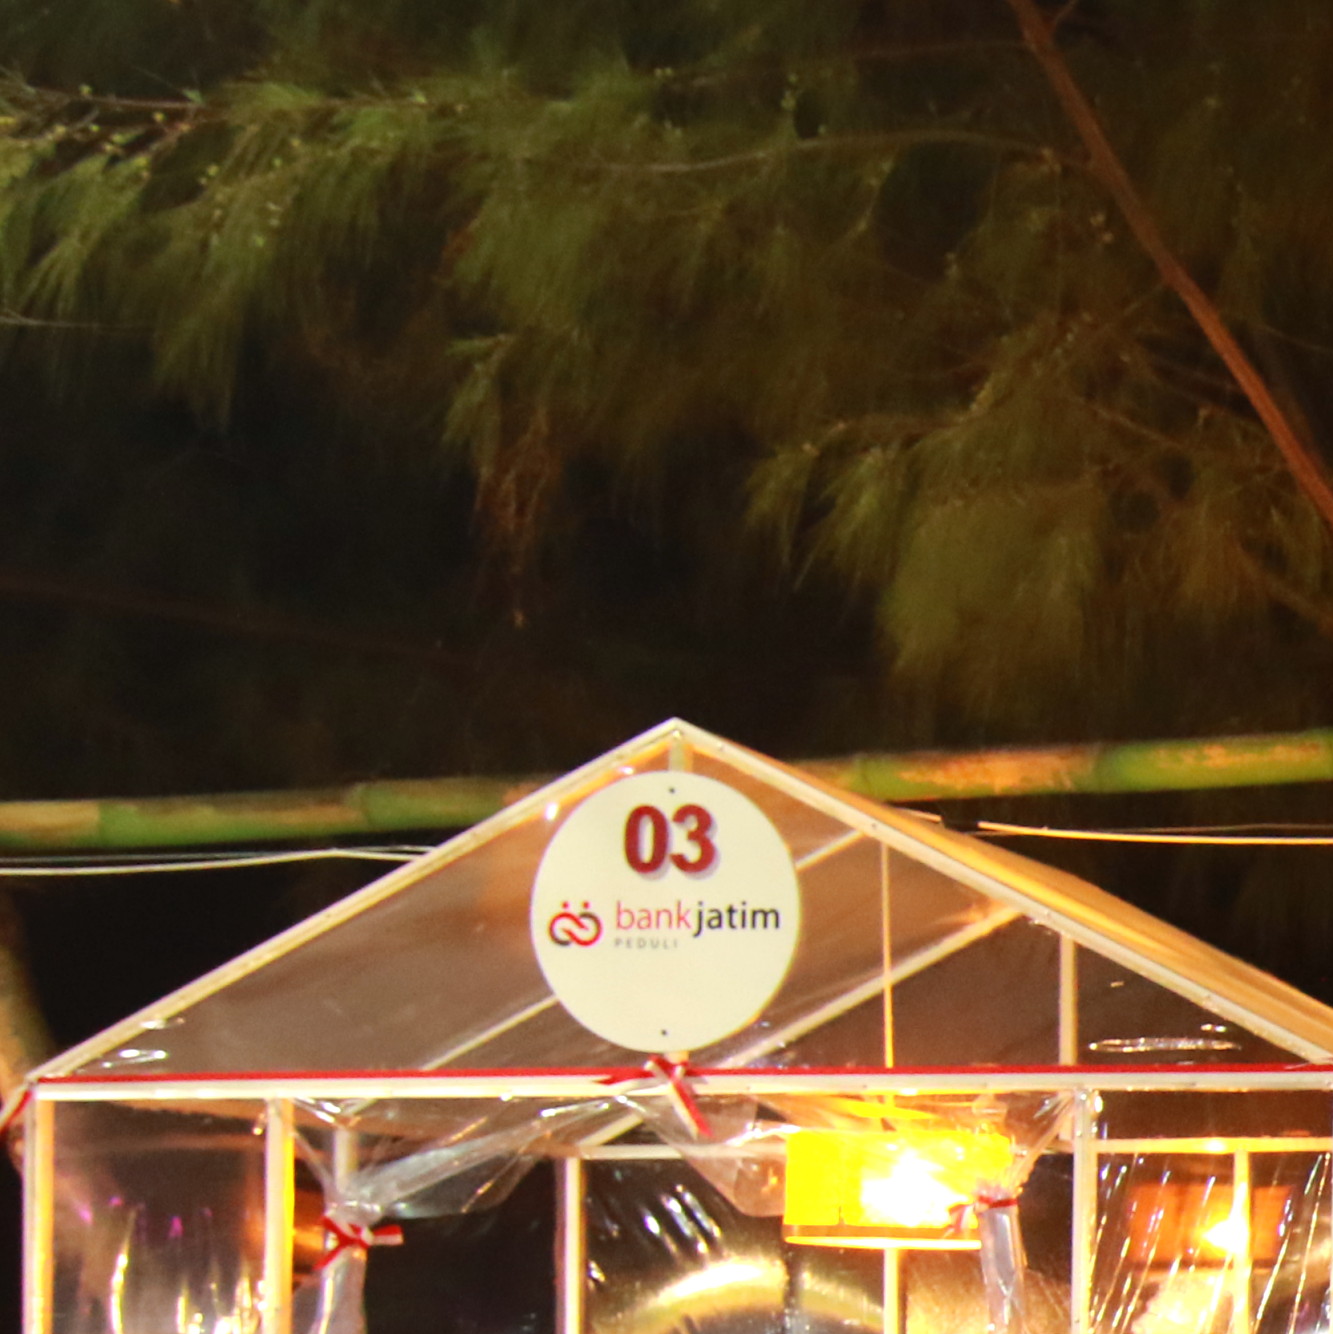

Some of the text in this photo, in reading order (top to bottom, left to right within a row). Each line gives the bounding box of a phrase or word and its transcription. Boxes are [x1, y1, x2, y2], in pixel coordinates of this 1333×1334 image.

[623, 804, 719, 875] 03
[616, 900, 780, 938] bankjatim
[614, 938, 678, 949] PEDULI
